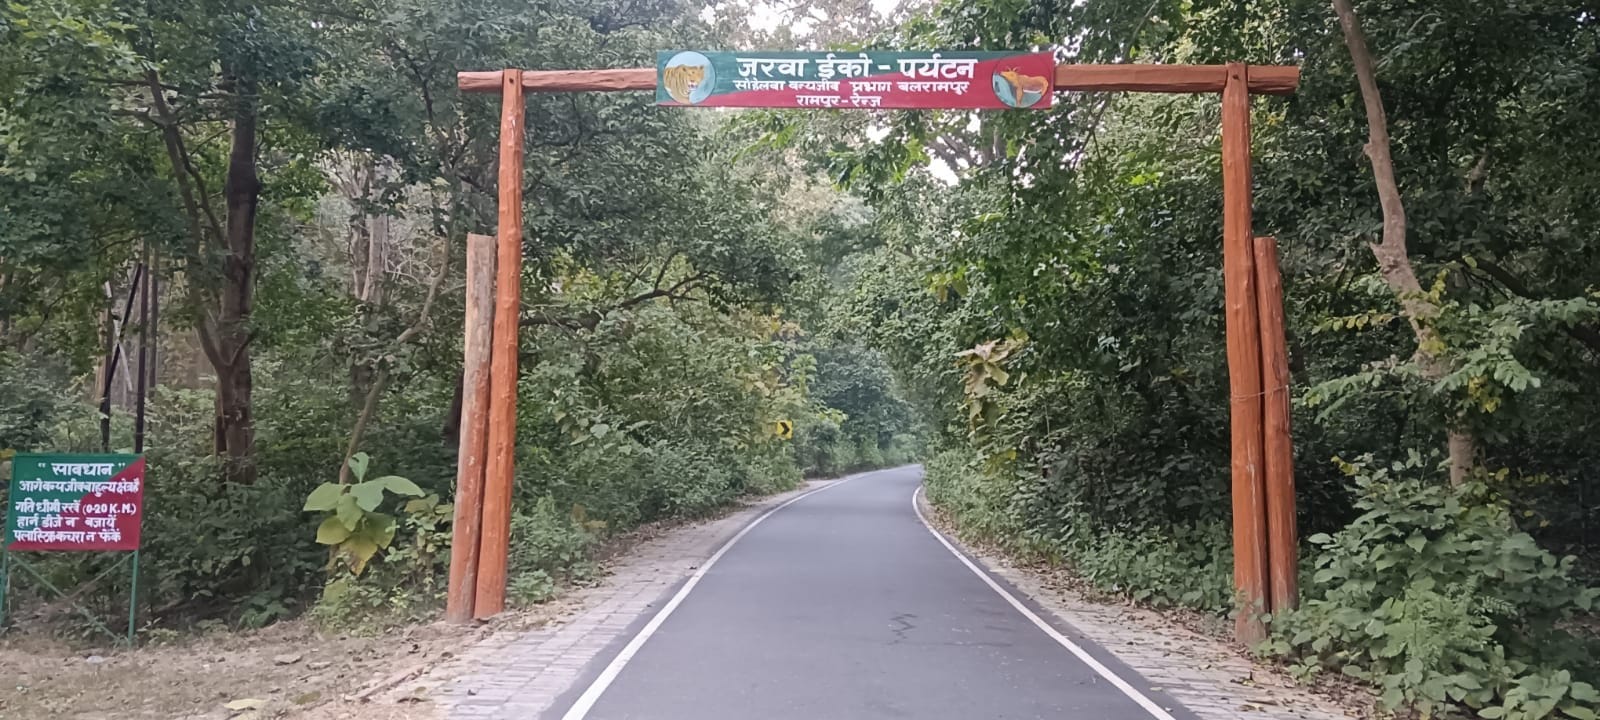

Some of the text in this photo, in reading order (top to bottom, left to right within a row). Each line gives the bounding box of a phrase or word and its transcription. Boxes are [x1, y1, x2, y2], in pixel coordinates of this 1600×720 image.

[736, 58, 810, 78] जरवा
[816, 53, 873, 79] ईको
[896, 53, 978, 79] पर्यटन
[896, 81, 970, 95] बलरामपुर
[51, 462, 114, 476] सावधान
[14, 498, 35, 513] गति
[64, 516, 80, 528] न
[86, 531, 96, 542] न
